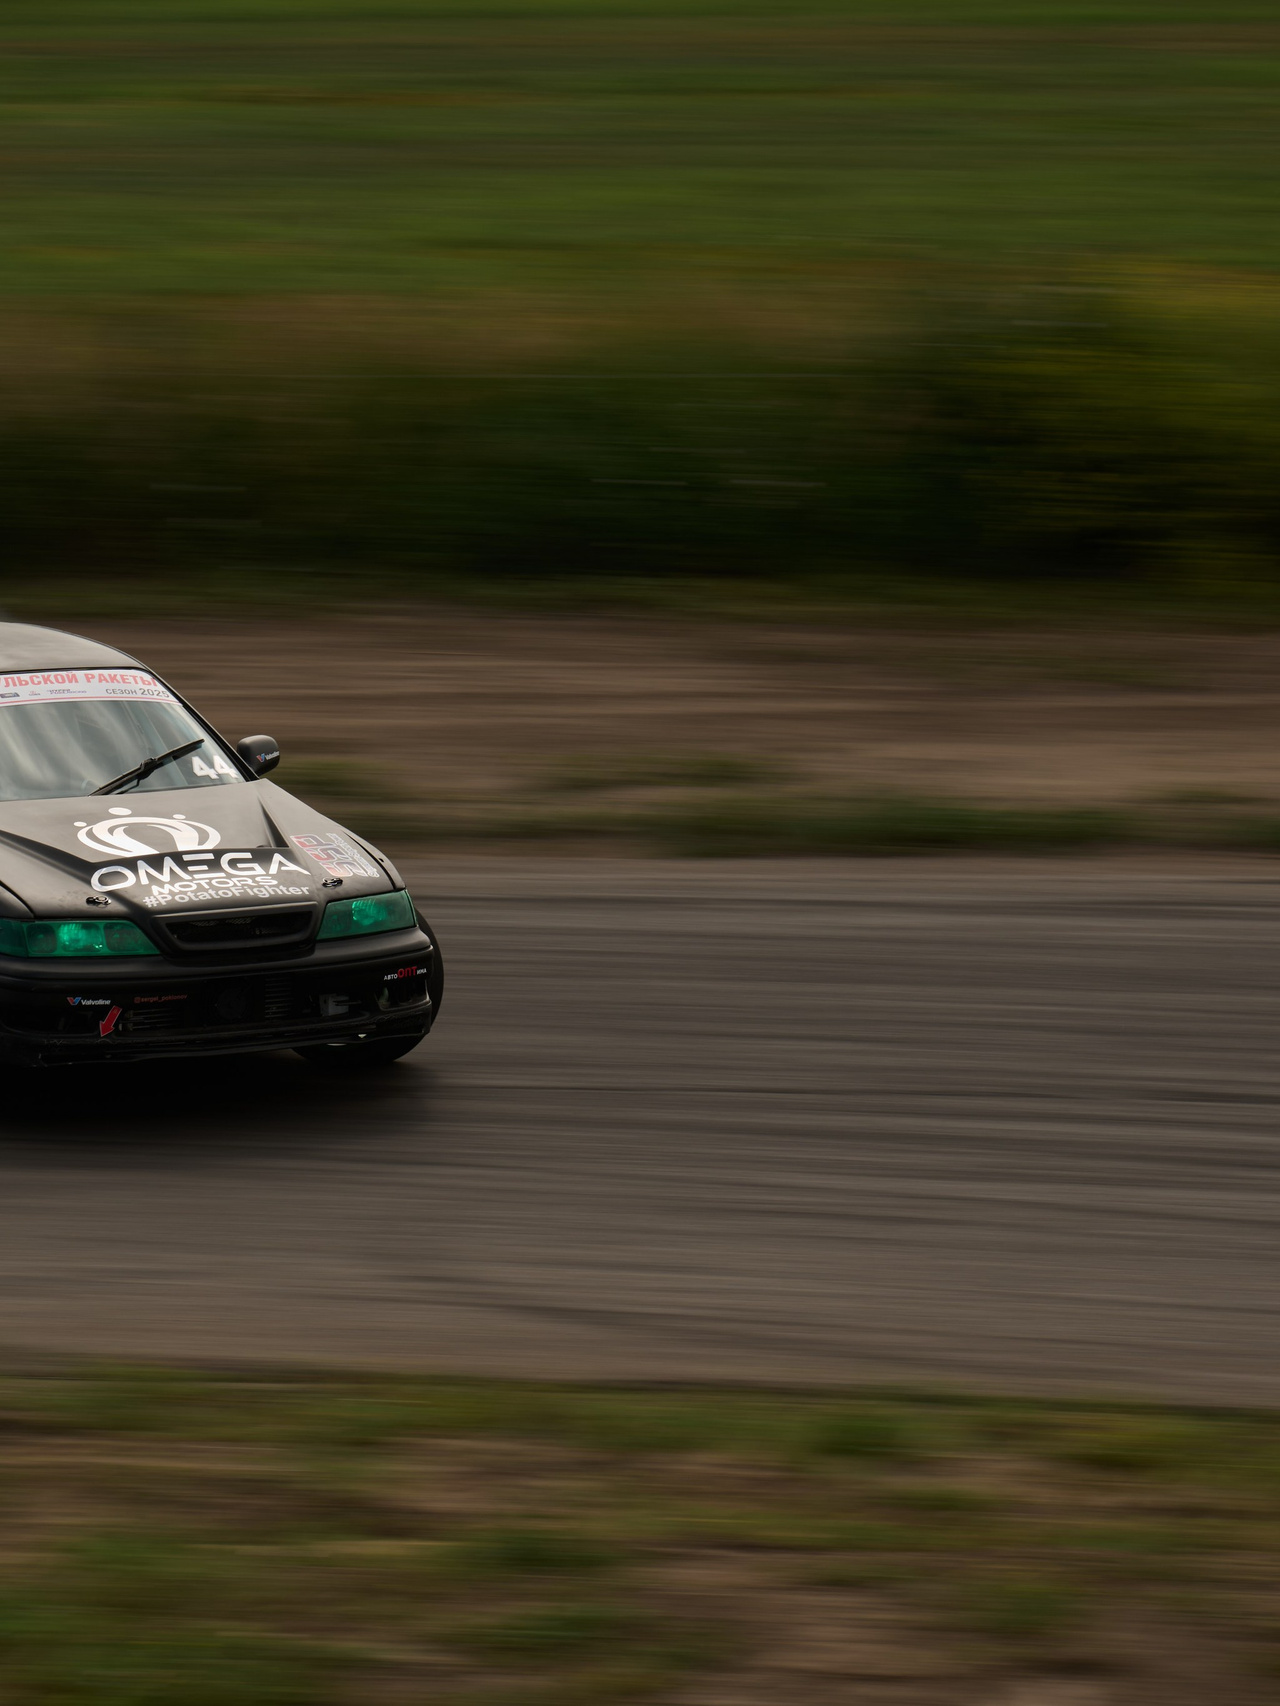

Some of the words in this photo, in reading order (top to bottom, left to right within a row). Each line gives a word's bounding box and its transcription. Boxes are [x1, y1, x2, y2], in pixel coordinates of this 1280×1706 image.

[84, 673, 158, 687] РАКЕТЫ
[105, 688, 137, 696] СЕЗОН
[139, 687, 170, 698] 2025
[191, 755, 240, 779] 44
[90, 851, 312, 892] OMEGA
[142, 884, 310, 908] #PotatoFighter
[150, 876, 278, 895] MOTORS
